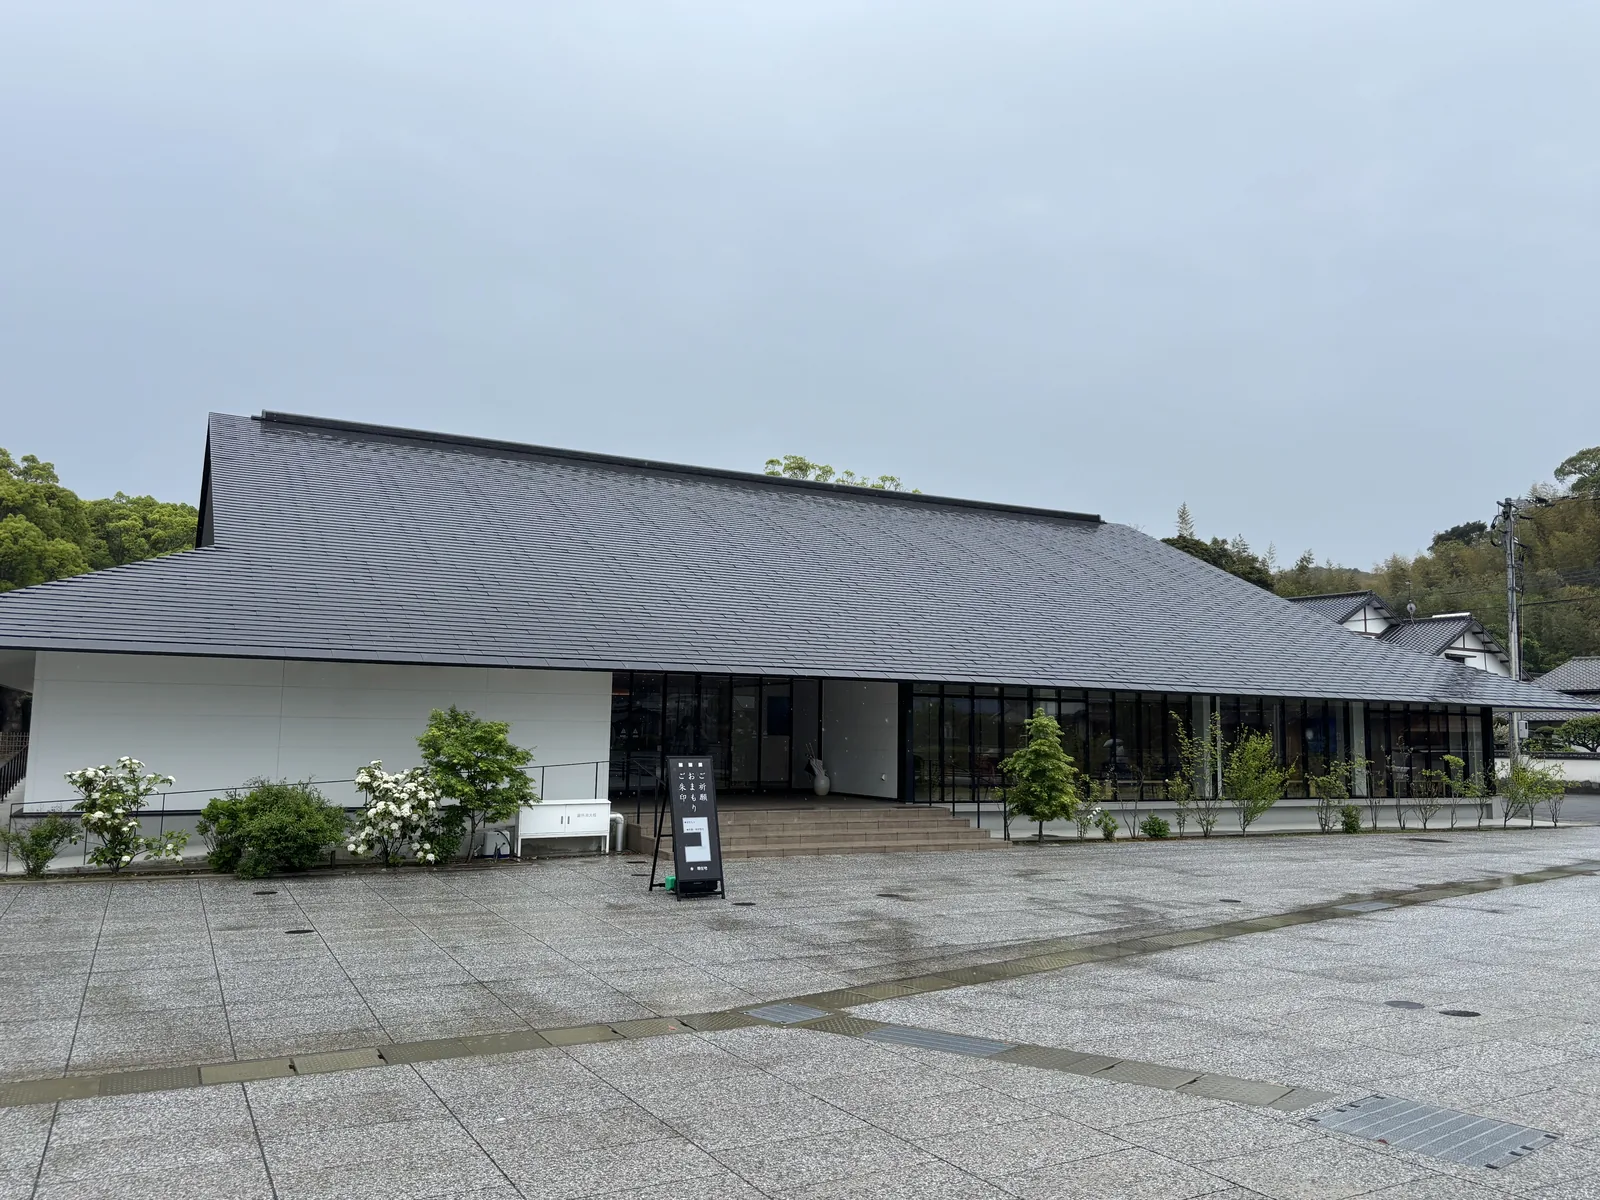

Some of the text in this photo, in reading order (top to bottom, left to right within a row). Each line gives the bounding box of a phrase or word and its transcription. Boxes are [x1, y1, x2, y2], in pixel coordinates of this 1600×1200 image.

[678, 772, 687, 802] ご朱印
[688, 772, 697, 812] おまもり
